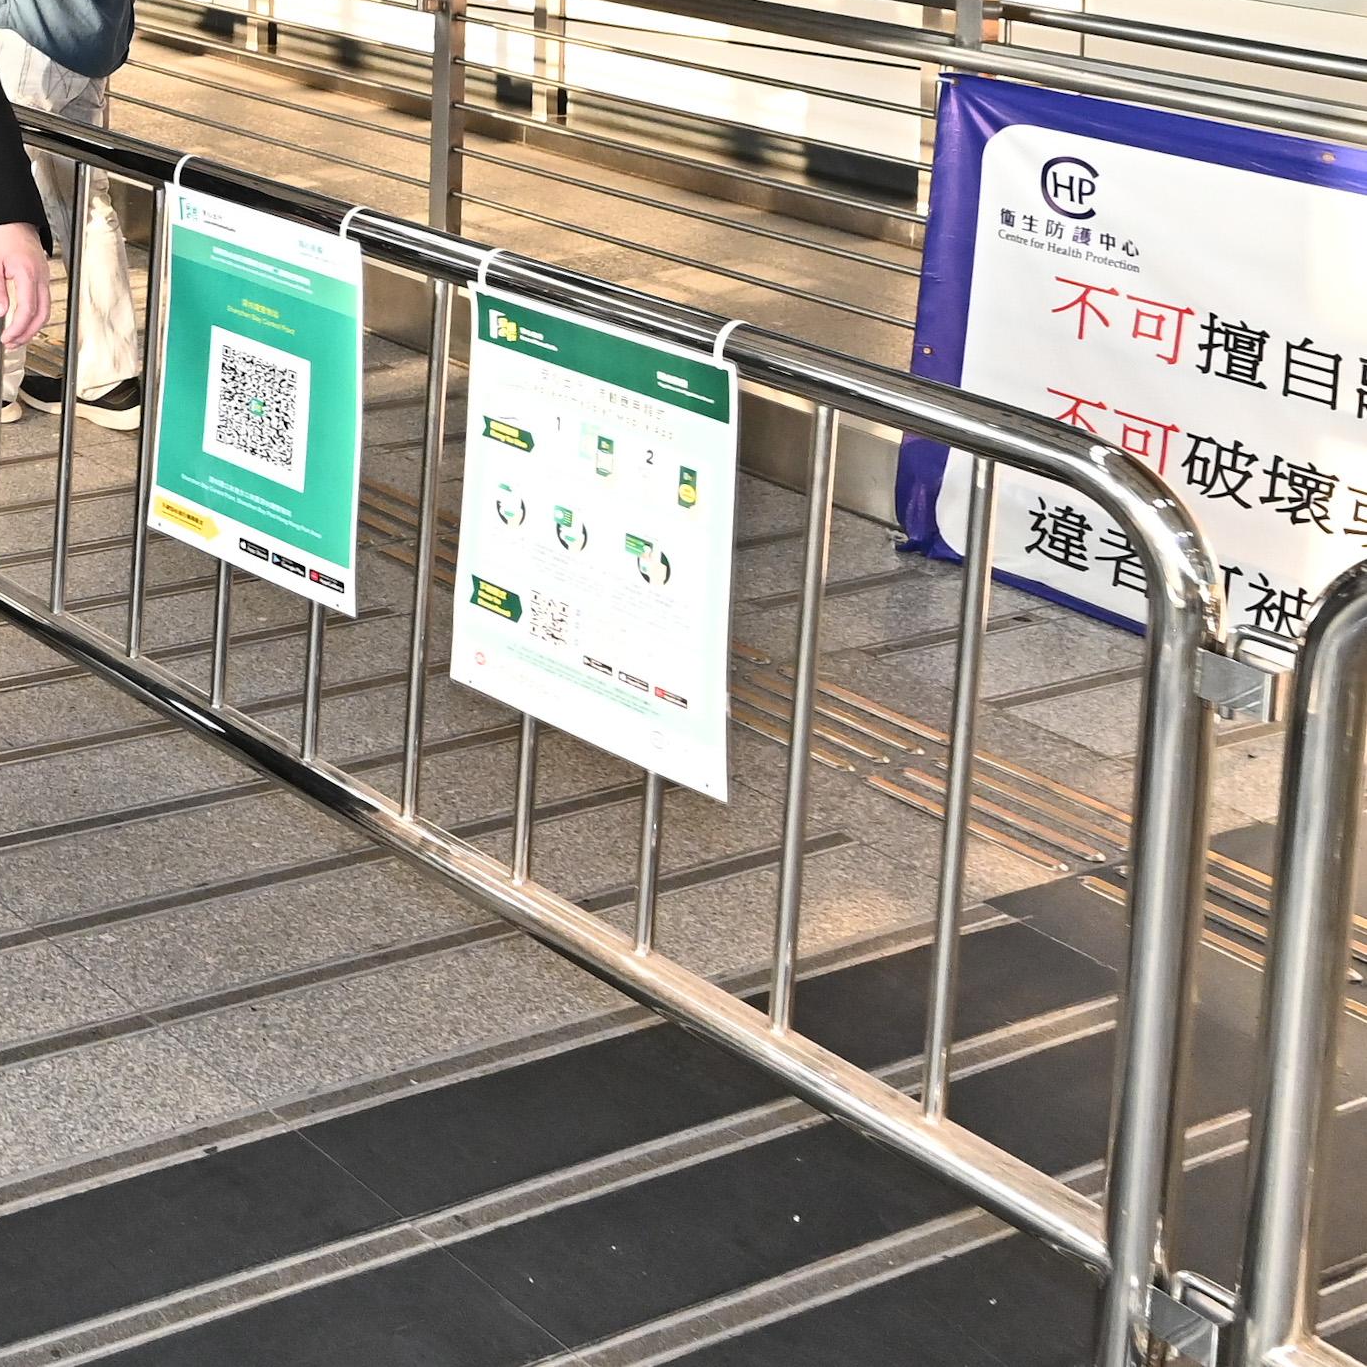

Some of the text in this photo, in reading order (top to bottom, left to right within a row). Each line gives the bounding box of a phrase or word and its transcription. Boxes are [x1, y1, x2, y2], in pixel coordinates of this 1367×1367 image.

[998, 229, 1140, 273] Centre for Health Protection
